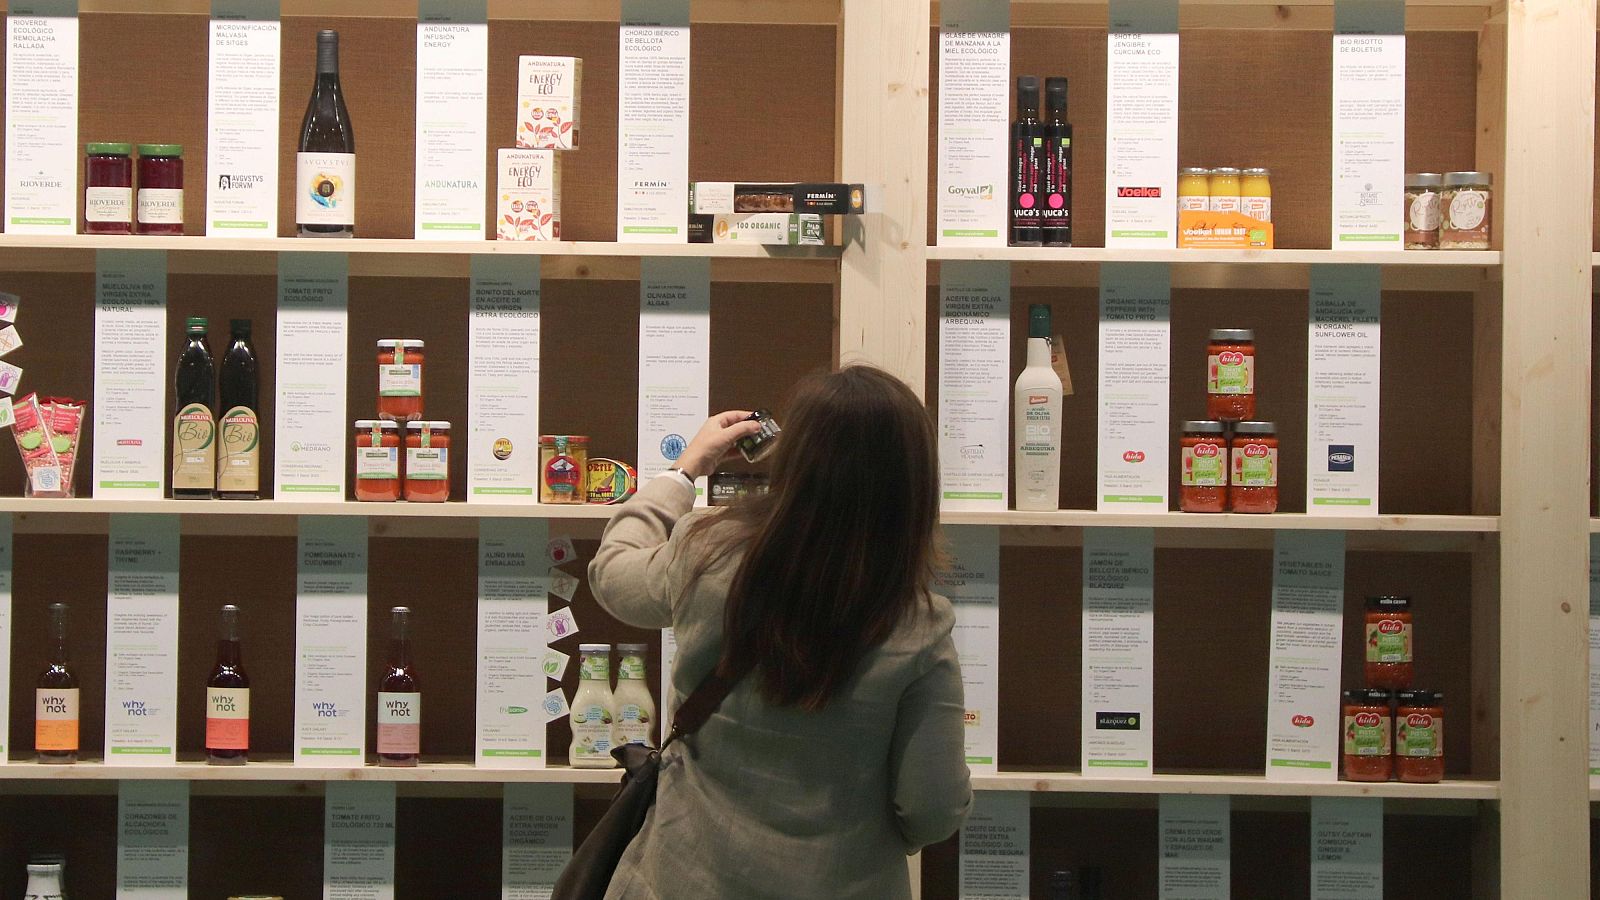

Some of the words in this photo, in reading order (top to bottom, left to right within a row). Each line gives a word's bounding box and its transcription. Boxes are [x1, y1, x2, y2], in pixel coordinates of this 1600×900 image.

[529, 73, 562, 86] ENERGY
[539, 84, 553, 94] ECO
[509, 166, 542, 179] ENERGY
[518, 177, 532, 187] ECO
[948, 185, 979, 196] Goyval
[1014, 208, 1040, 217] yuca's
[1044, 208, 1068, 217] yuca's
[180, 422, 207, 440] Bio
[225, 425, 252, 443] Bio
[42, 696, 65, 705] why
[123, 700, 144, 708] why
[386, 701, 408, 709] why
[46, 705, 66, 713] not
[216, 703, 235, 712] not
[313, 702, 335, 710] why
[392, 708, 410, 716] not
